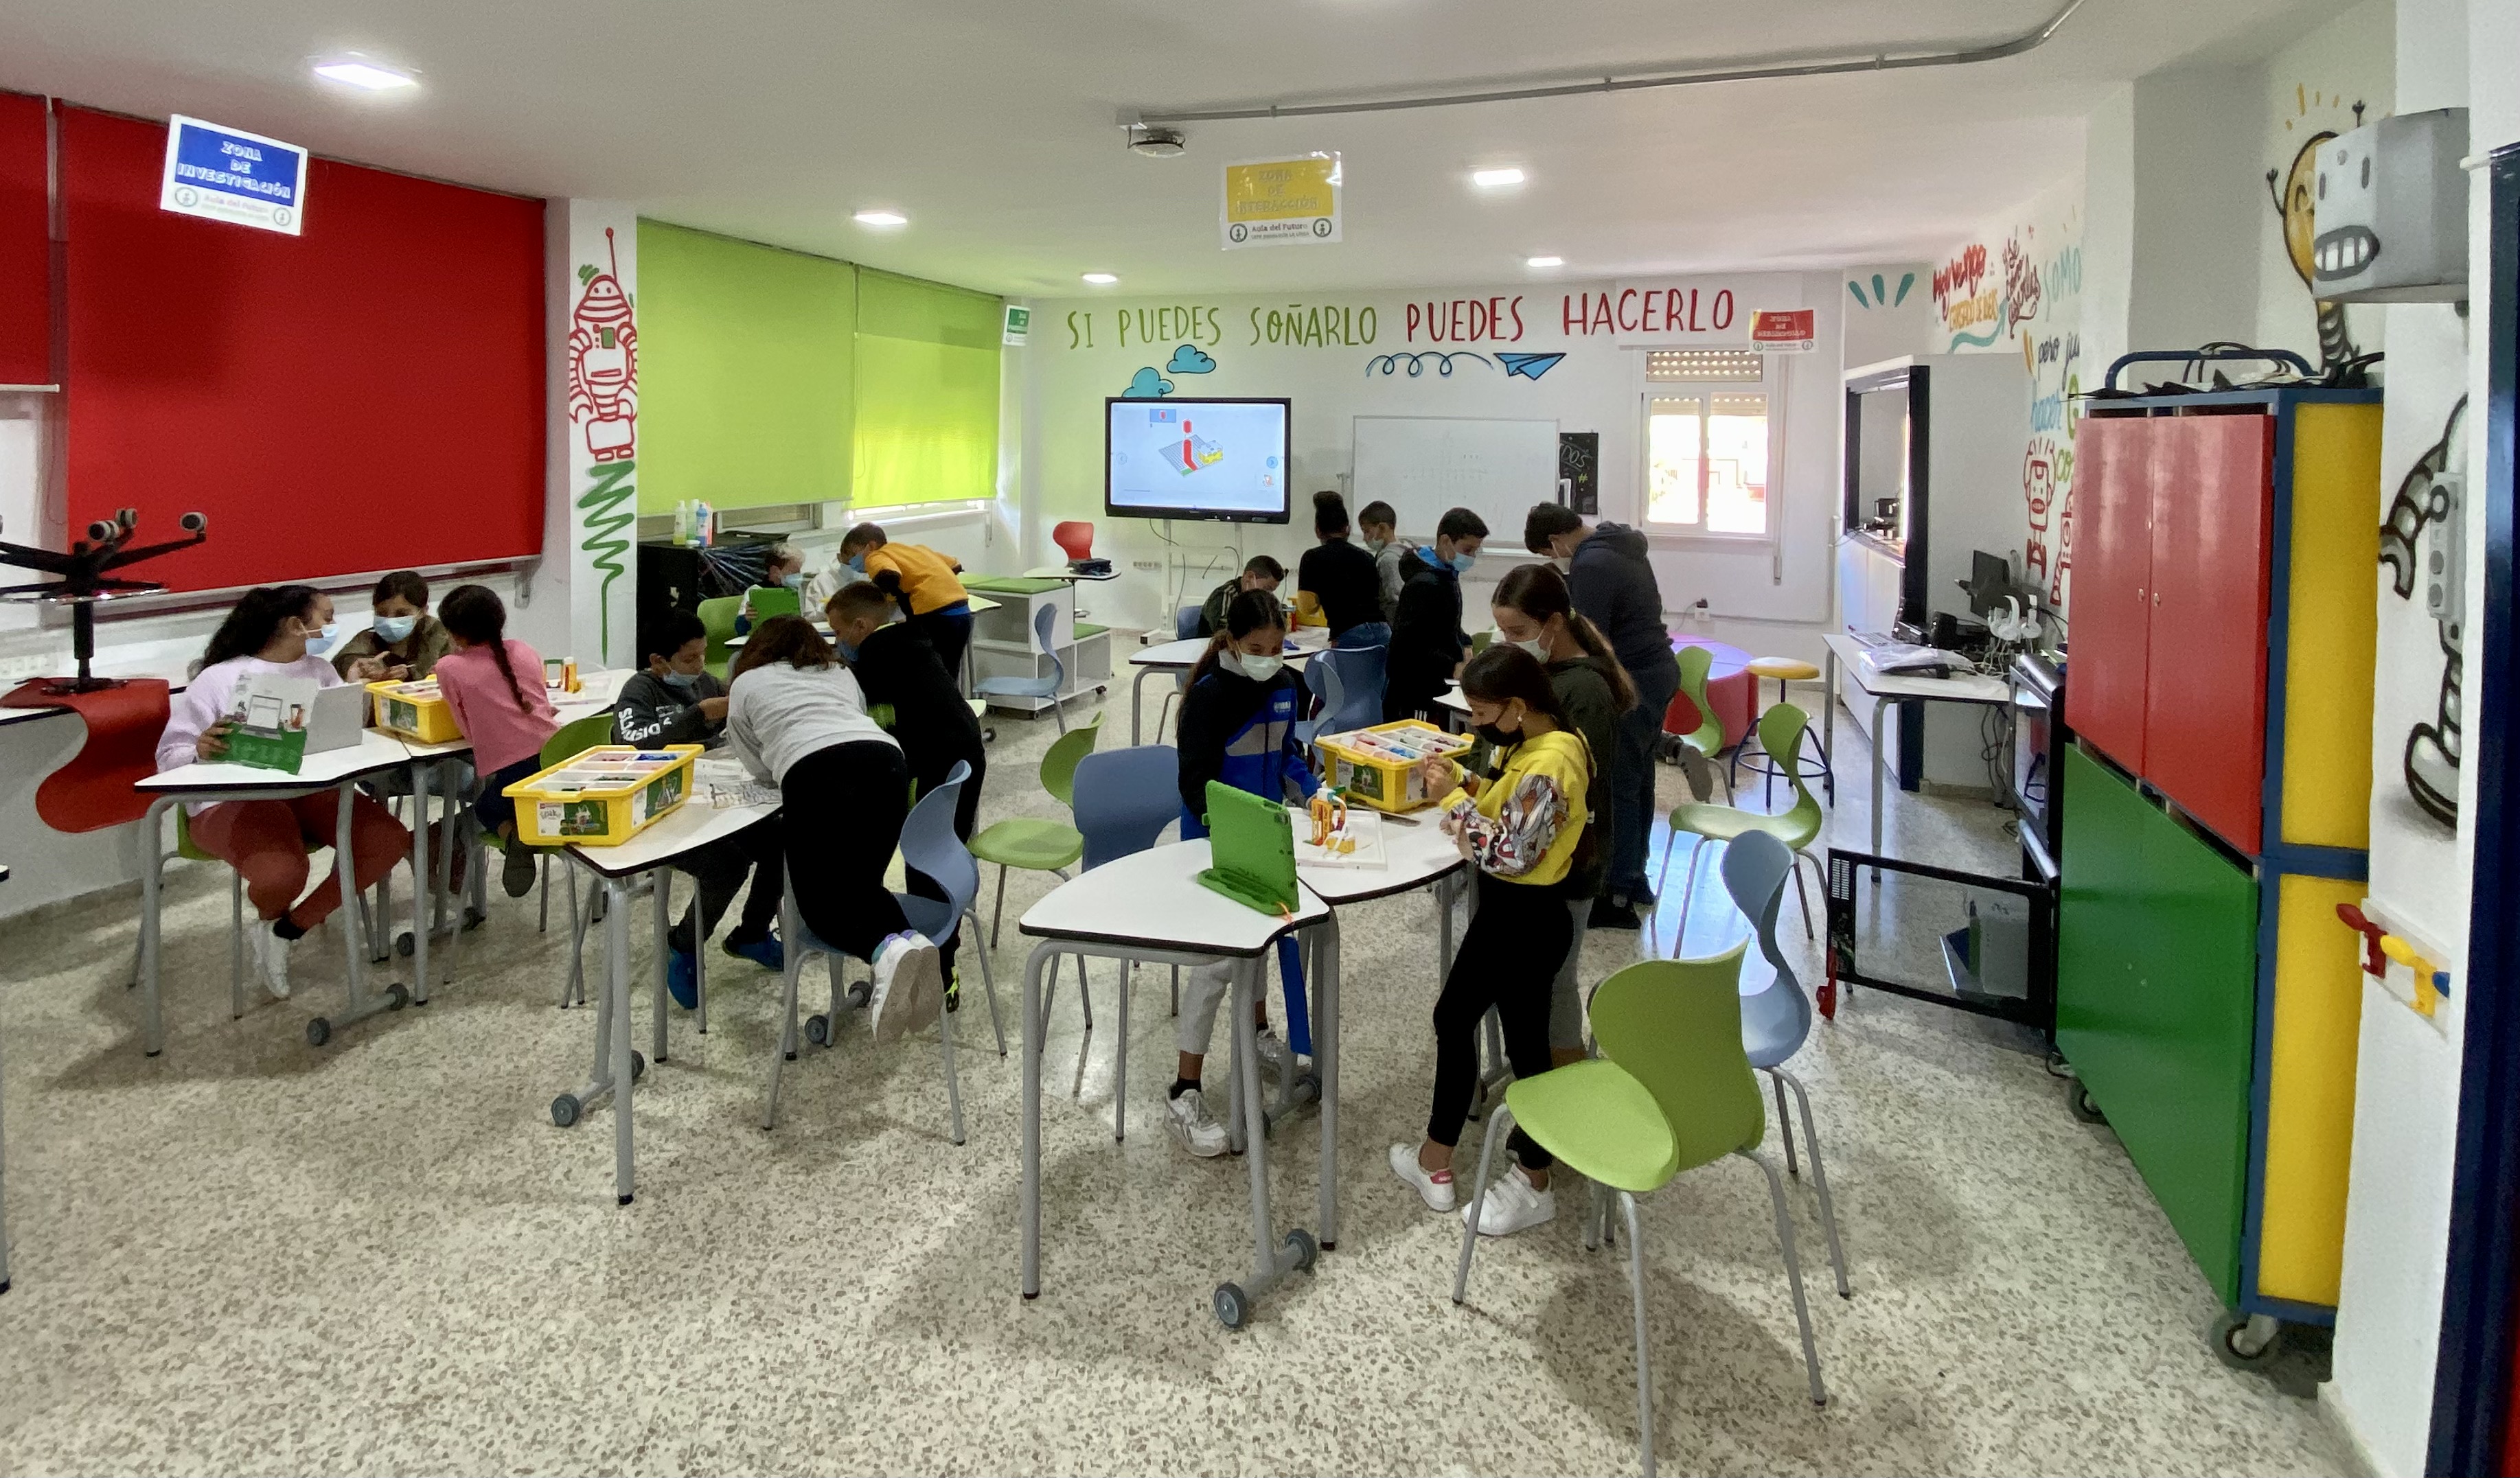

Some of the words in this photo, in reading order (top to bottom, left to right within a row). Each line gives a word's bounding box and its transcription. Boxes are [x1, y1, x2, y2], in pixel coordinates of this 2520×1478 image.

[220, 139, 262, 161] ZONA
[176, 162, 291, 199] INVESTIGACIÓN
[230, 159, 251, 174] DE
[1067, 310, 1094, 349] SI
[1119, 305, 1222, 347] PUEDES
[1250, 303, 1377, 347] SOÑARLO
[1407, 295, 1525, 343] PUEDES
[1563, 288, 1734, 336] HACERLO
